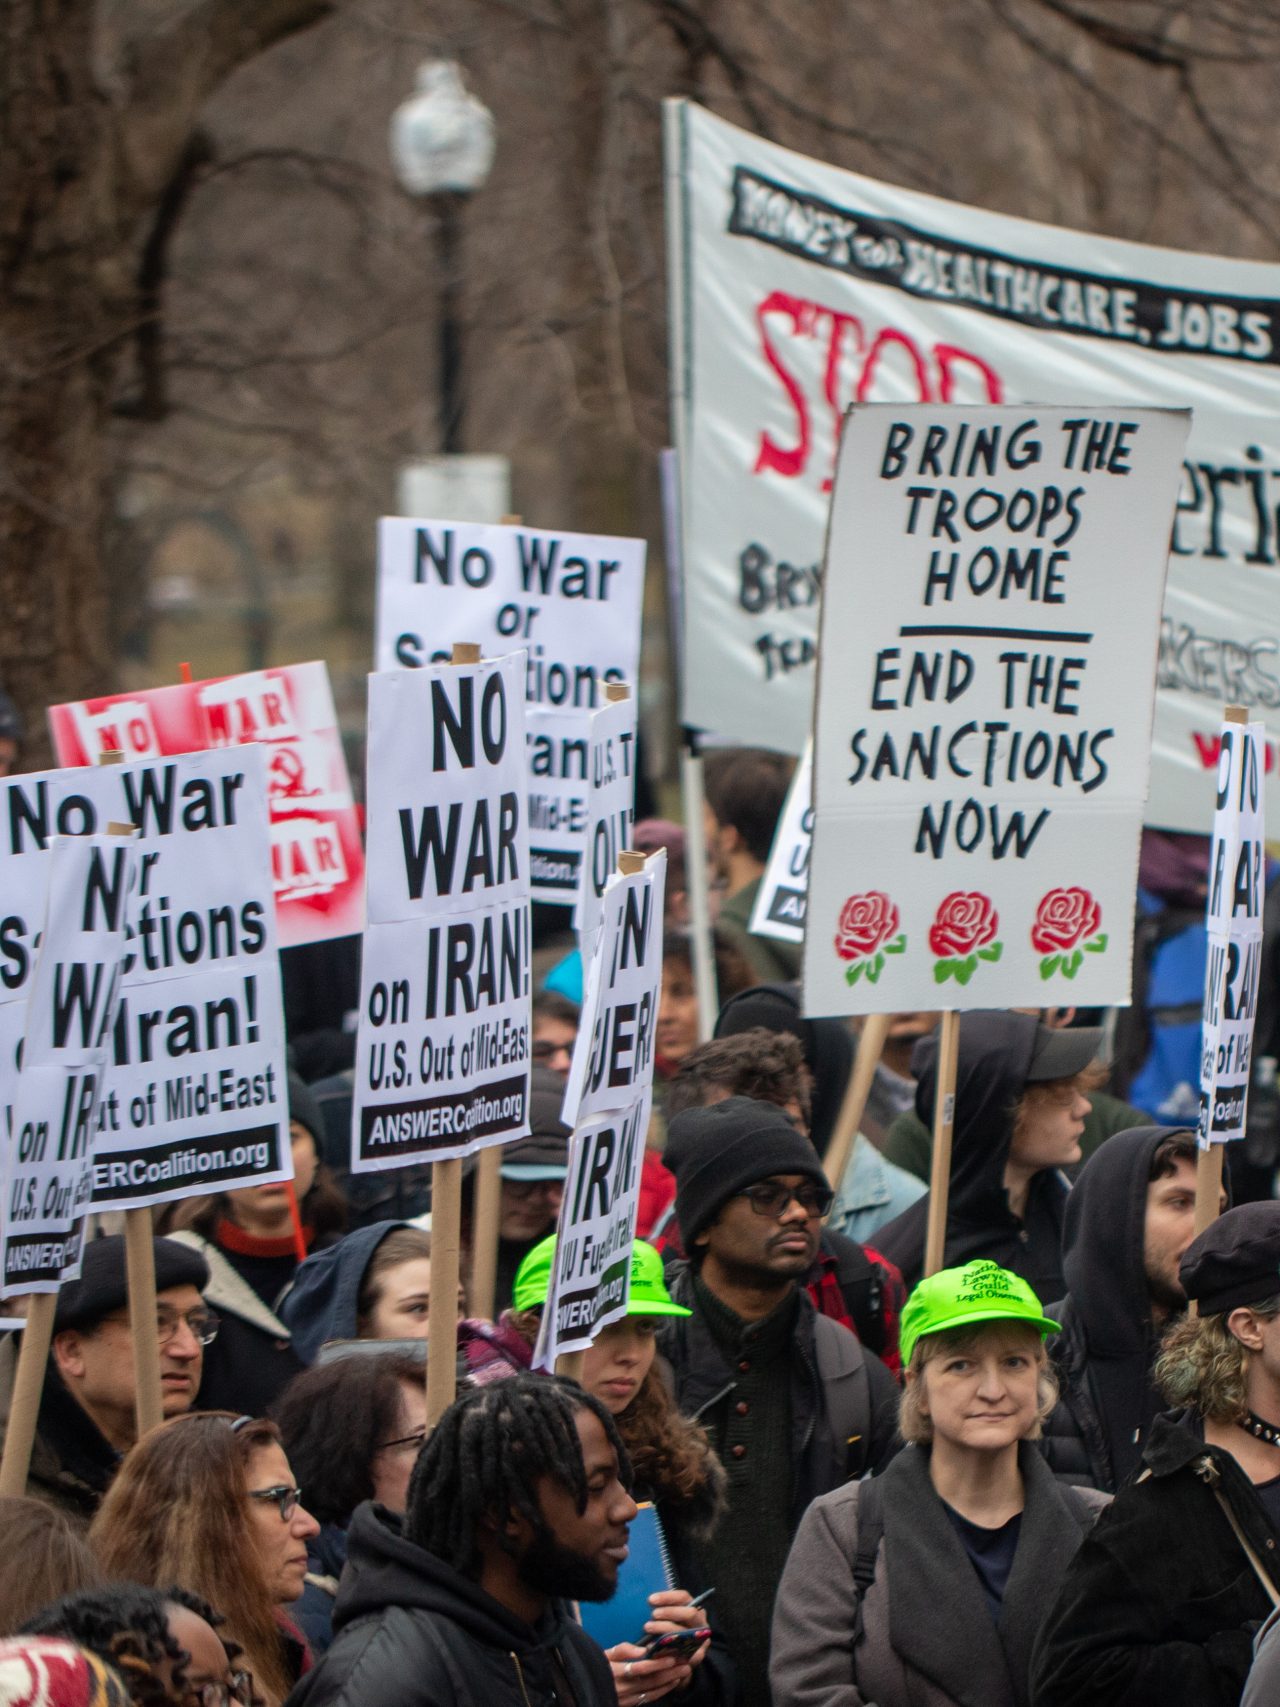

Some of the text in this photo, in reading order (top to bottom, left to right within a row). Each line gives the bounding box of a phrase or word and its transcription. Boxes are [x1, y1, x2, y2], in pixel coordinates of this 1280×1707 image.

[902, 238, 1152, 344] HEALTHCARE,
[1160, 299, 1273, 360] JOBS
[879, 418, 1141, 480] BRING THE
[905, 485, 1087, 547] TROOPS
[413, 527, 623, 602] No War
[923, 546, 1073, 606] HOME
[495, 601, 541, 640] or
[870, 647, 976, 711] END
[998, 650, 1089, 716] THE
[97, 691, 287, 756] NO WAR
[430, 671, 508, 772] NO
[846, 719, 1117, 794] SANCTIONS
[8, 763, 245, 855] No War
[913, 798, 1052, 861] NOW
[399, 791, 520, 900] WAR
[368, 904, 530, 1028] on IRAN!
[112, 976, 260, 1067] Iran!
[368, 1016, 530, 1091] U.S. Out of Mid-East
[130, 1082, 157, 1129] of
[165, 1062, 277, 1123] Mid-East
[367, 1092, 524, 1147] ANSWERCoalition.org
[19, 1119, 49, 1164] on
[10, 1177, 37, 1222] U.S.
[972, 1281, 1009, 1291] Guild
